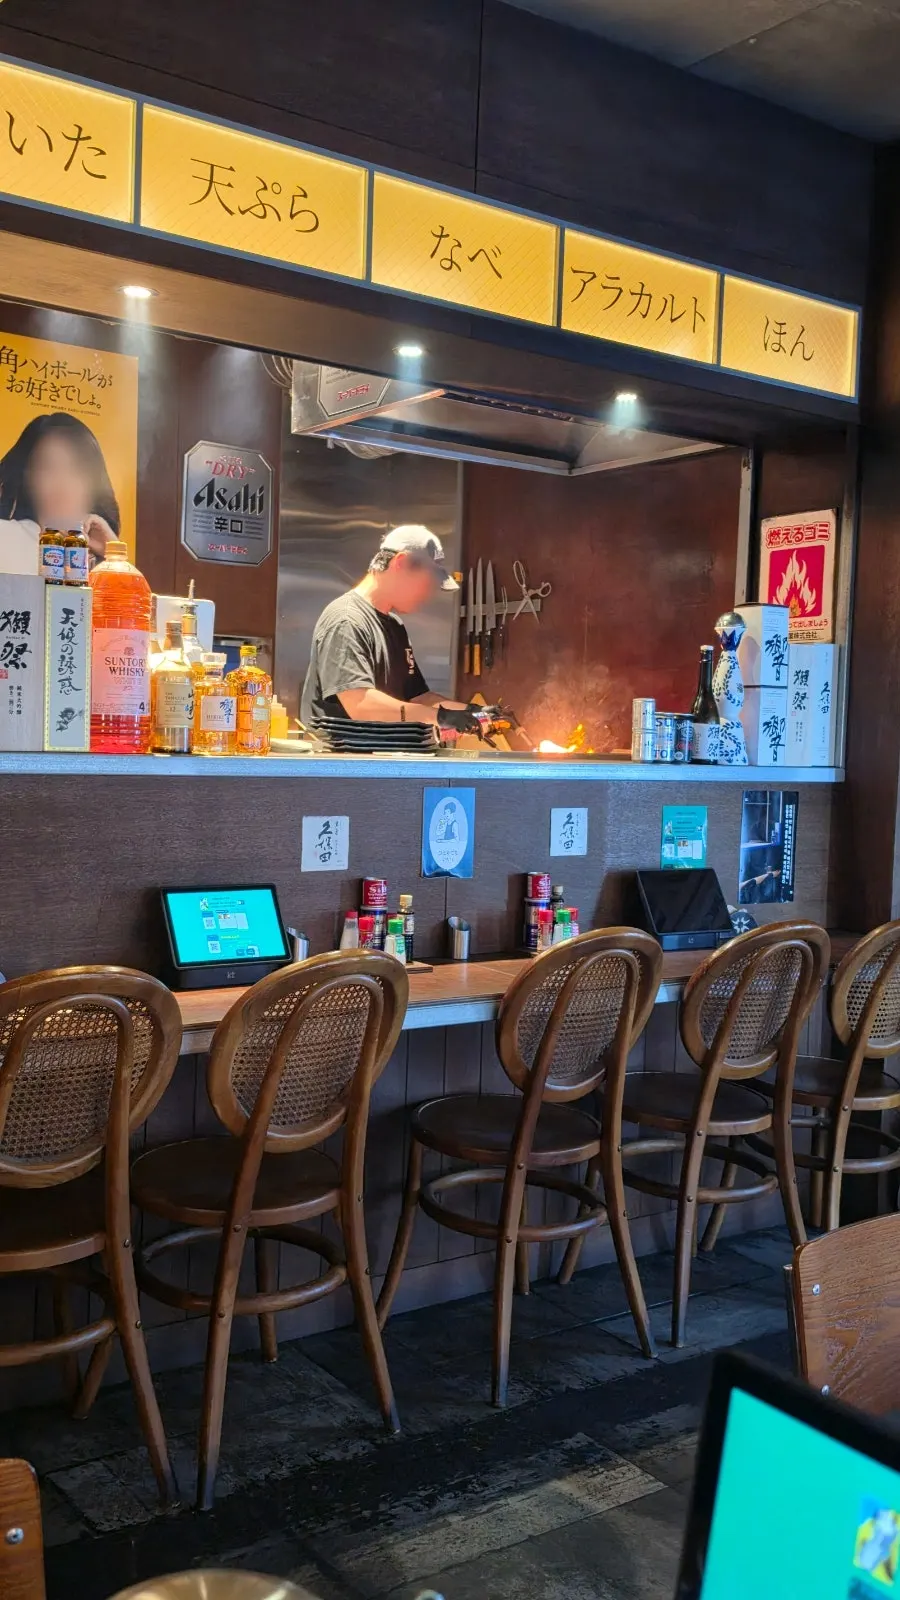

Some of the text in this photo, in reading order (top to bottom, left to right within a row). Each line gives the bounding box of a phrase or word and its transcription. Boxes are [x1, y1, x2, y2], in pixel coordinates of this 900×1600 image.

[5, 110, 107, 180] いた
[189, 157, 320, 233] 天ぷら
[430, 224, 503, 279] なべ
[570, 265, 706, 334] アラカルト
[763, 315, 814, 361] ほん
[0, 345, 113, 389] 角ハイボールが
[6, 375, 102, 409] お好きでしょ。
[193, 477, 265, 516] Asahi
[214, 516, 243, 534] 辛口
[767, 523, 829, 547] 燃えるゴミ
[57, 607, 83, 696] 天使の誘惑
[108, 666, 145, 677] WHISKY
[315, 820, 333, 863] 久保田
[560, 812, 574, 850] 久保田
